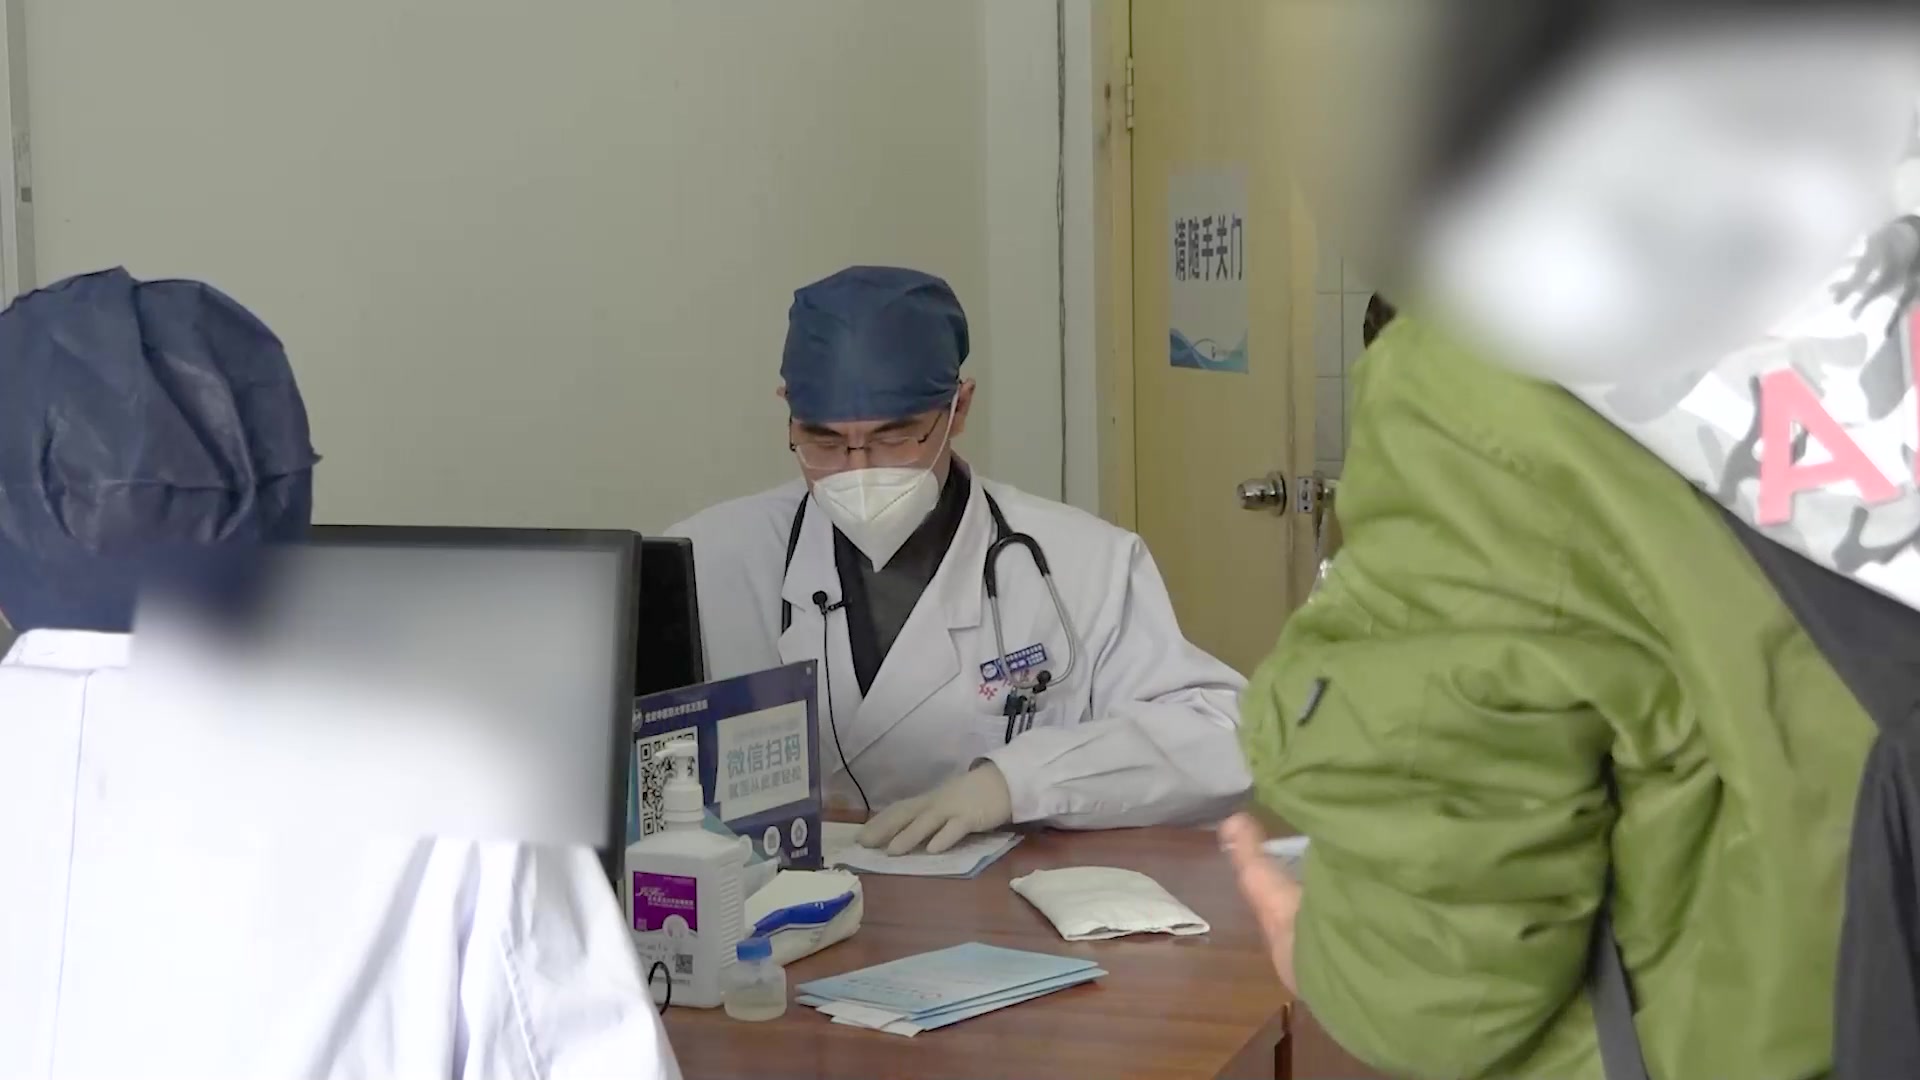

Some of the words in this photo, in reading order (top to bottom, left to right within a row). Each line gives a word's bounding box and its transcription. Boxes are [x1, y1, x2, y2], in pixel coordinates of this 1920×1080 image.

[1174, 212, 1243, 281] 请随手关门
[727, 733, 801, 778] 微信扫码
